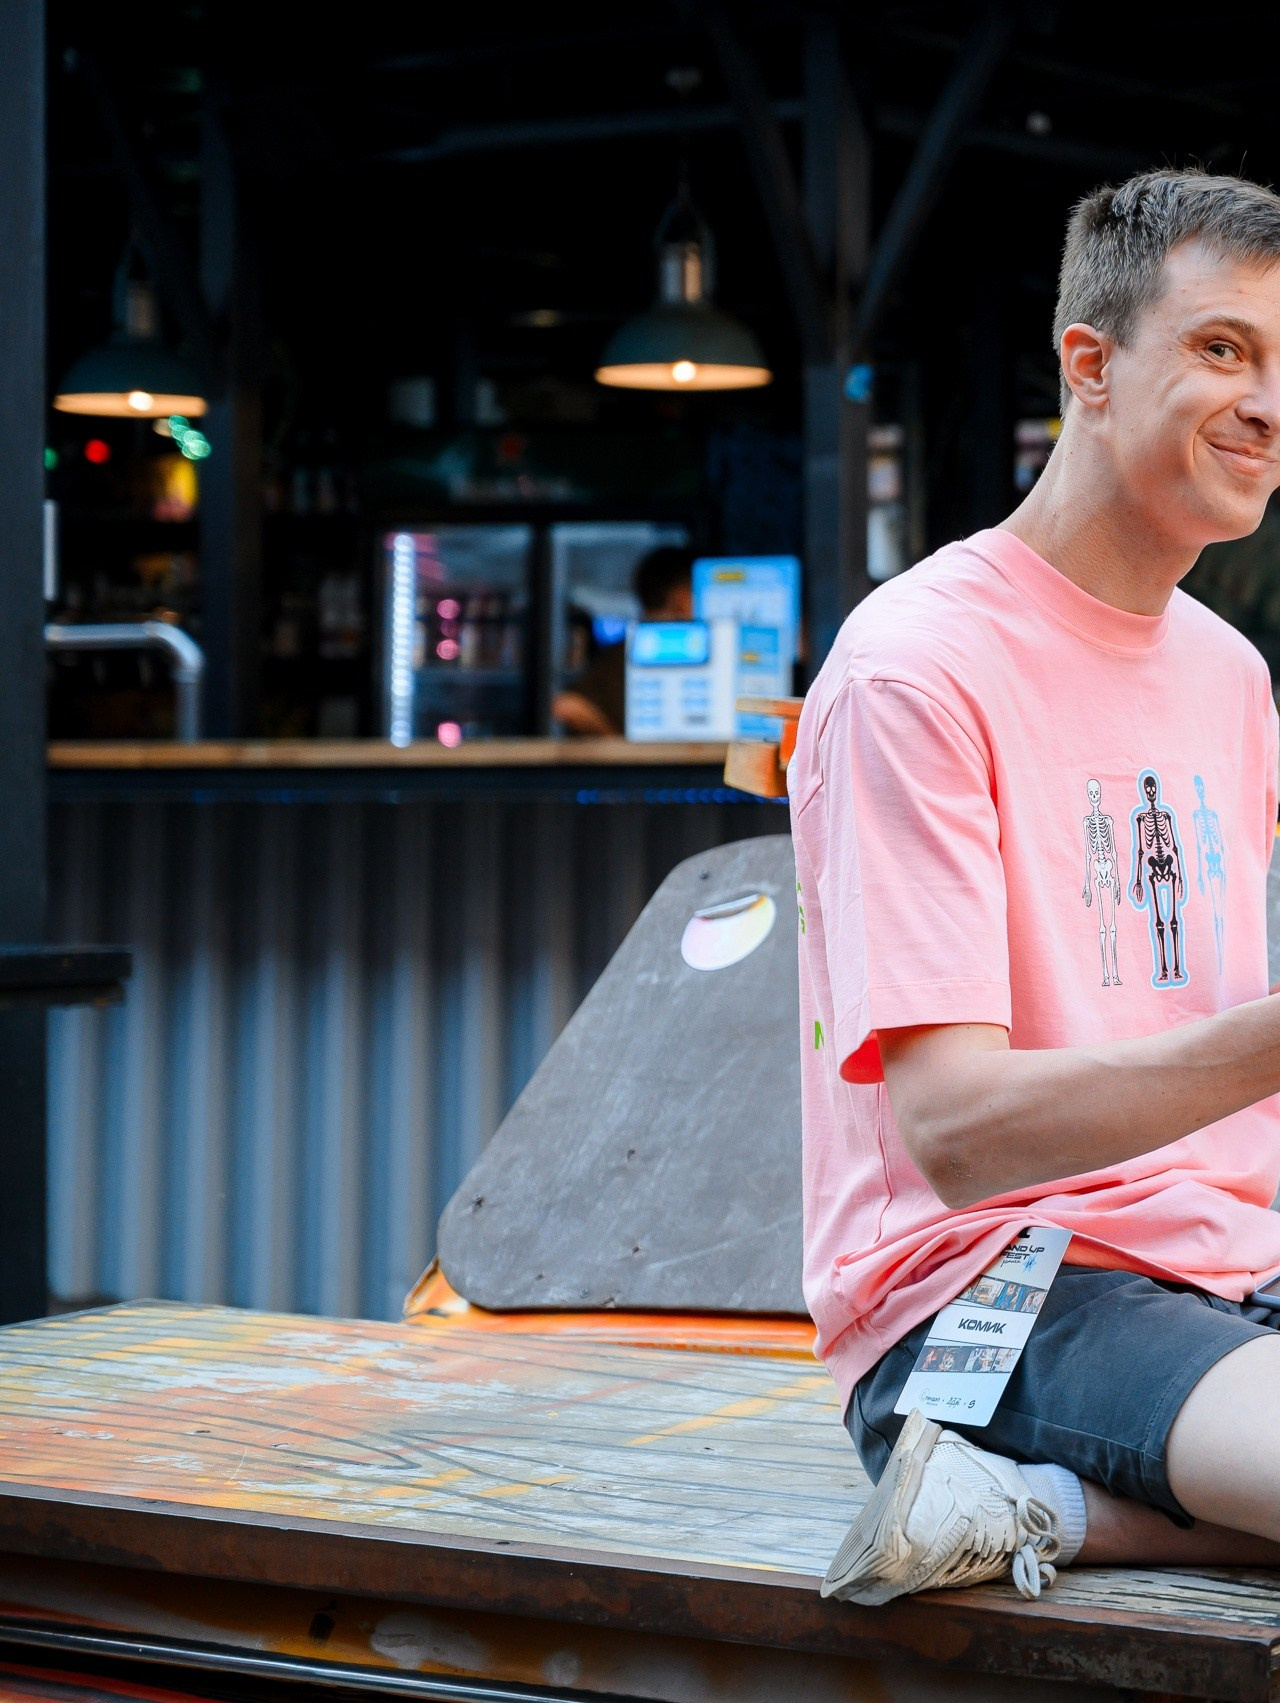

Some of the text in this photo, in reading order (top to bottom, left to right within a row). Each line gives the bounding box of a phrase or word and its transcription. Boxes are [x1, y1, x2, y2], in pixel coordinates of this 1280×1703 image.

[1005, 1244, 1045, 1253] AND UP
[999, 1251, 1030, 1260] FEST
[958, 1318, 1007, 1334] КОМИК
